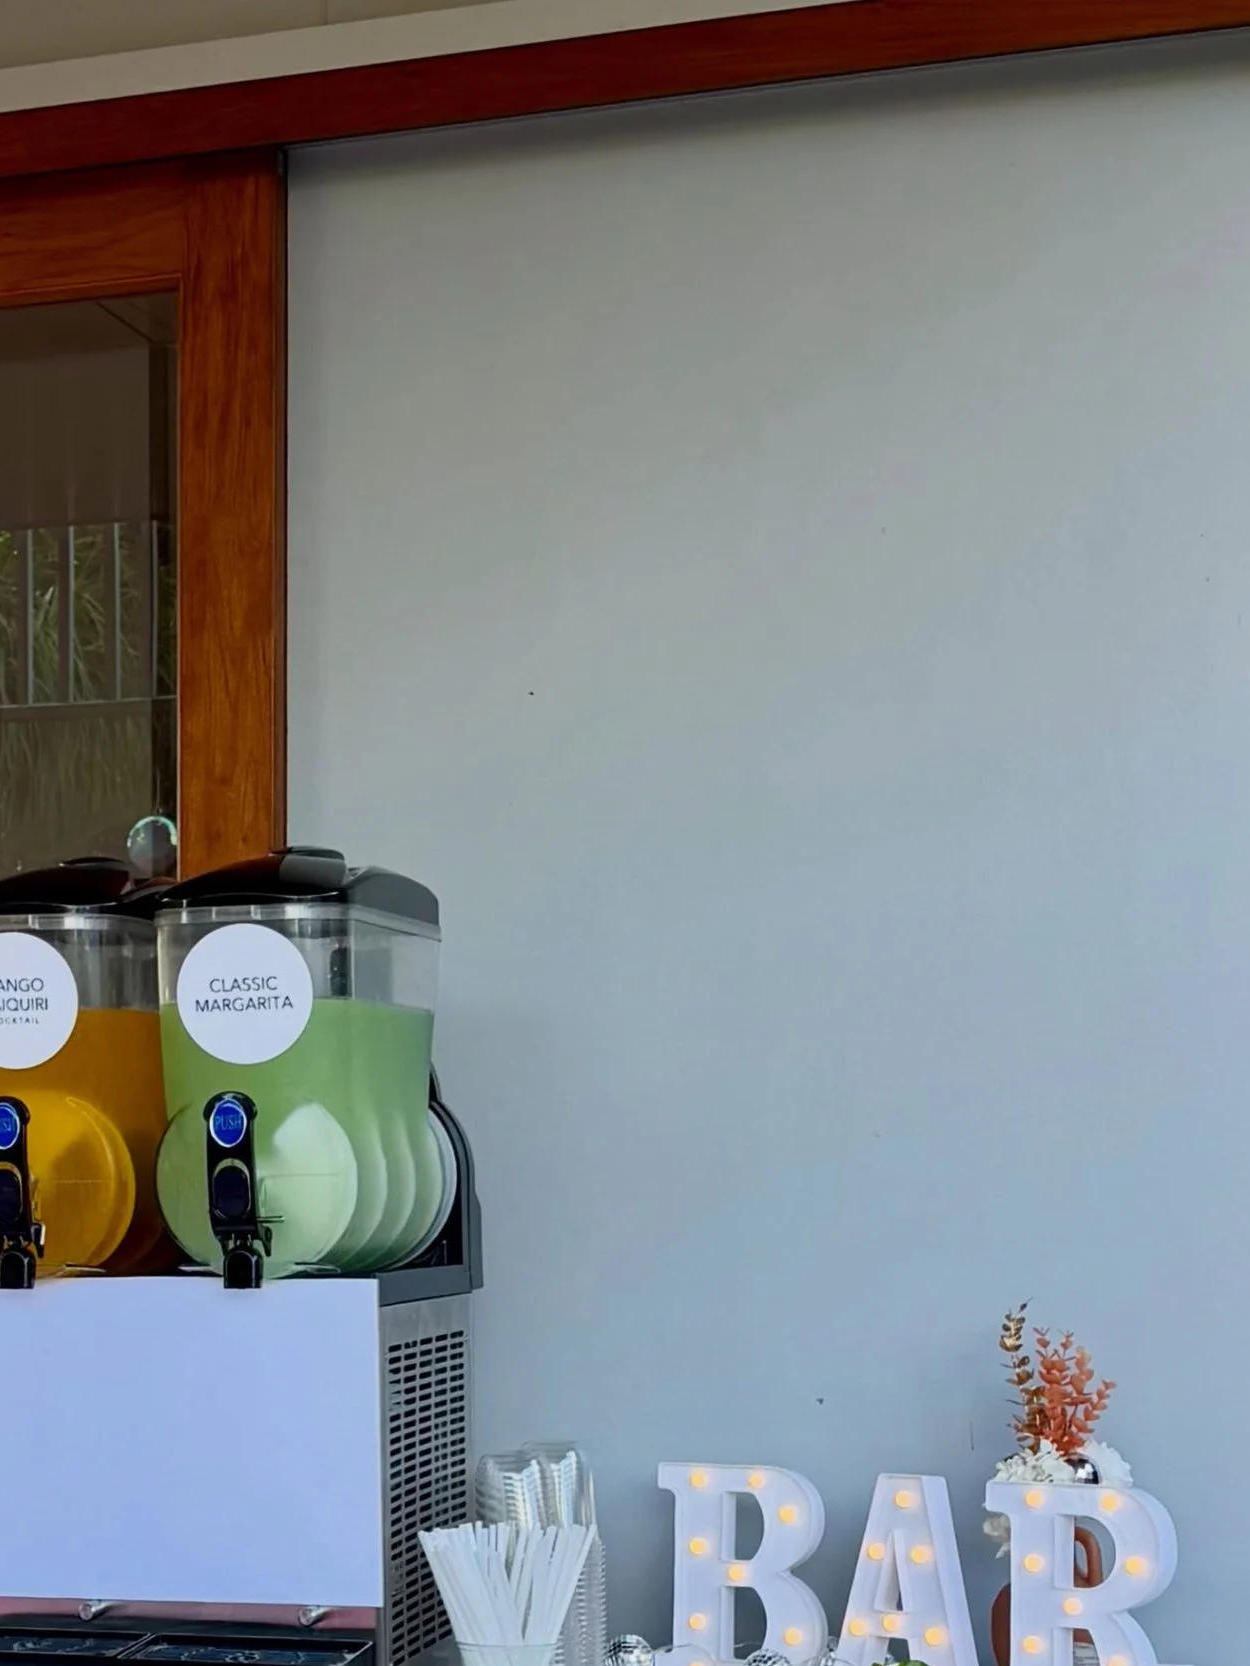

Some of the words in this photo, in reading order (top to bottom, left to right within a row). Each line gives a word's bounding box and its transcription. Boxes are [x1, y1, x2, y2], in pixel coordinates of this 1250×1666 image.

[209, 975, 278, 993] CLASSIC
[195, 995, 294, 1013] MARGARITA
[213, 1114, 242, 1131] PUSH
